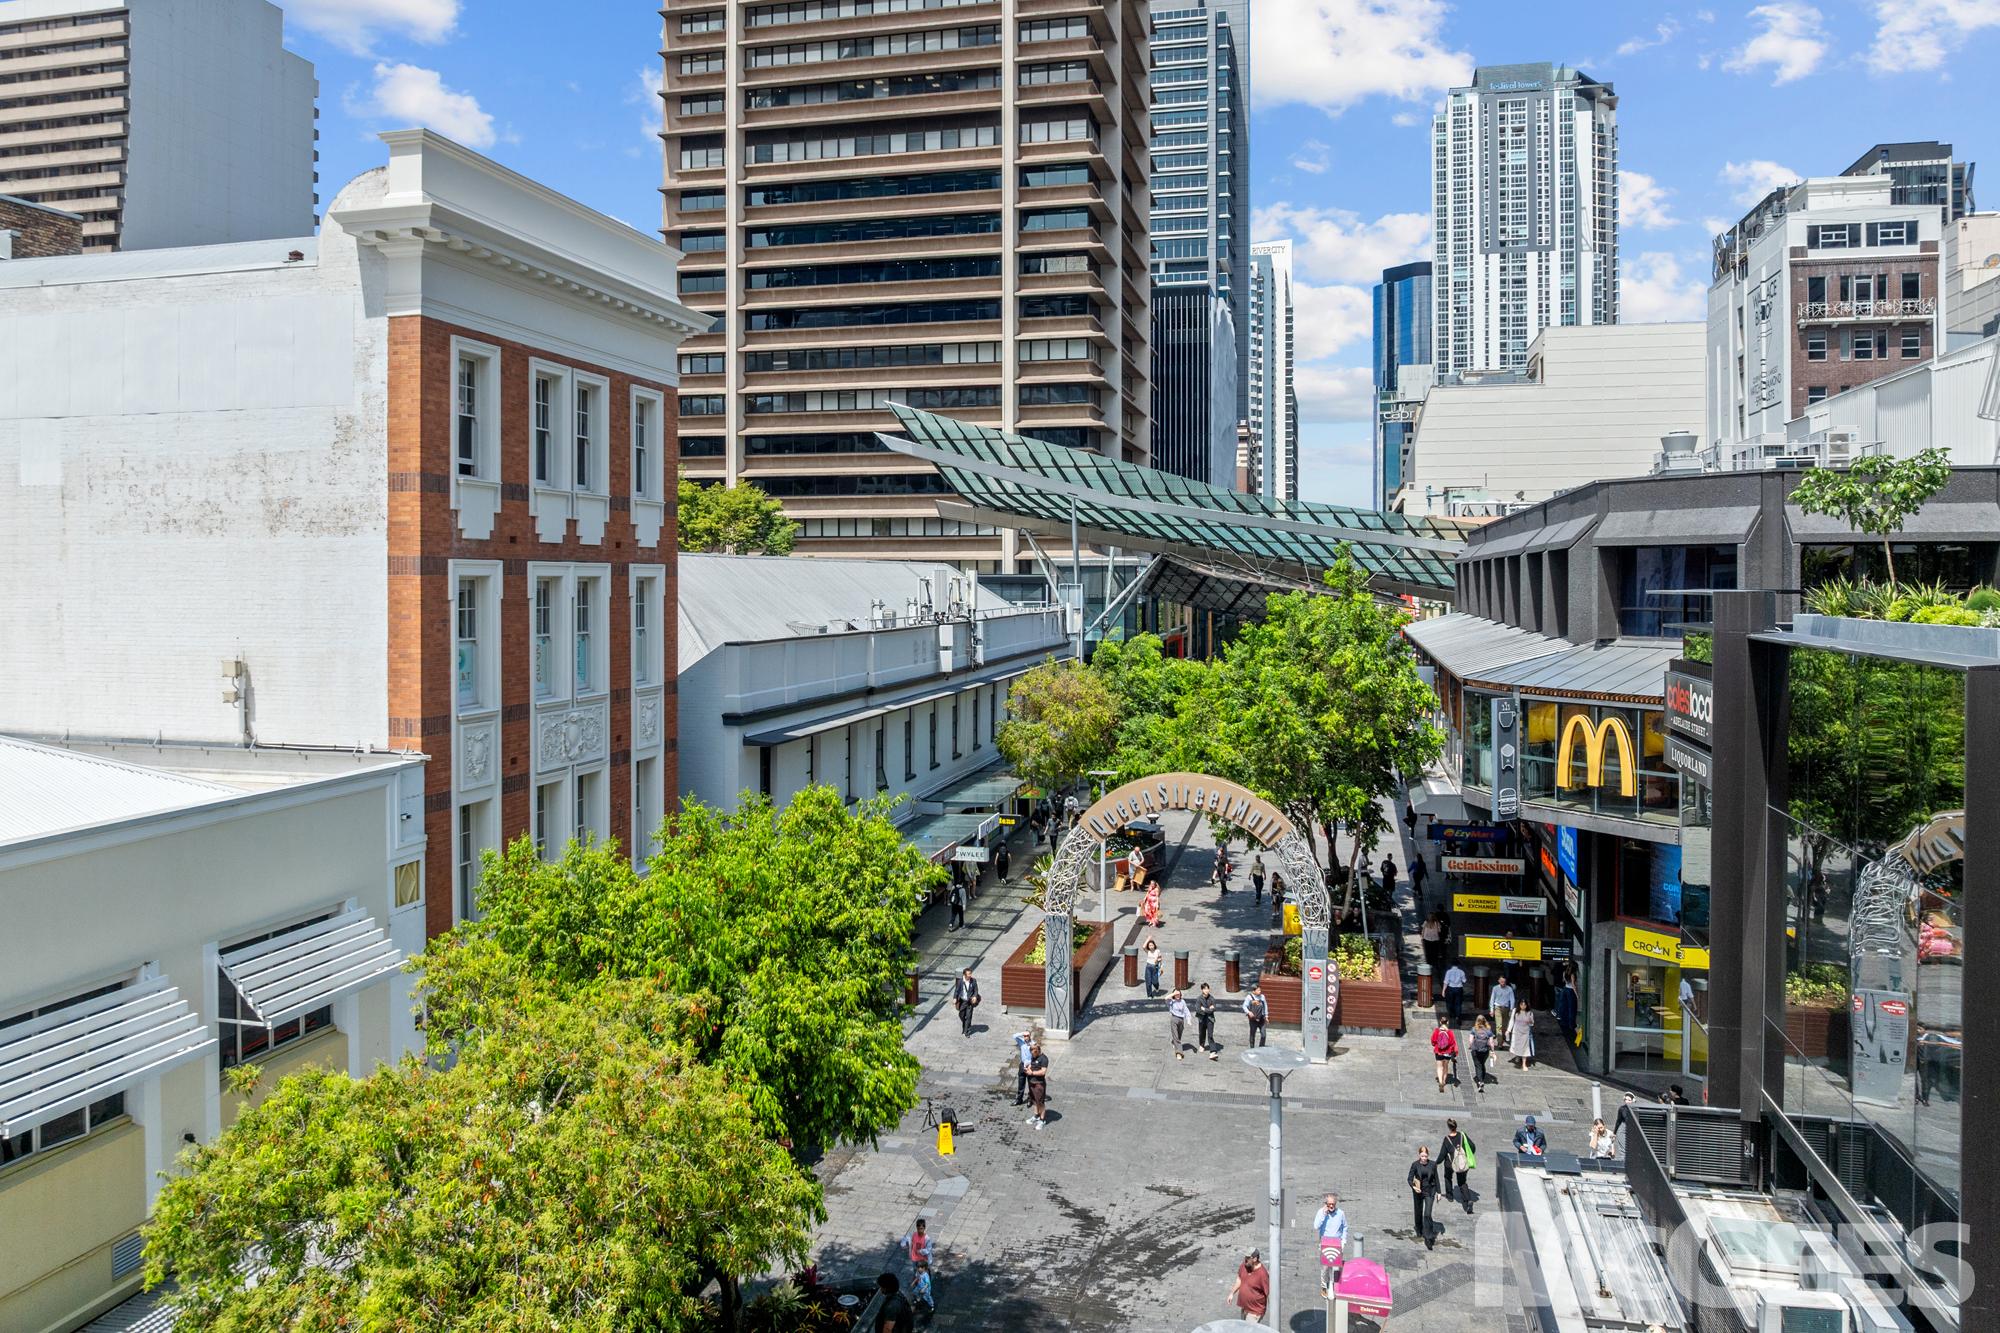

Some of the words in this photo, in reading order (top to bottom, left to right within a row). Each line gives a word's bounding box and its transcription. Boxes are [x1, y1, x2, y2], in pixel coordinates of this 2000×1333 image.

[1691, 721, 1707, 738] STREET
[1671, 747, 1707, 778] LIQUORLAND
[1448, 859, 1519, 873] Gelatissimo
